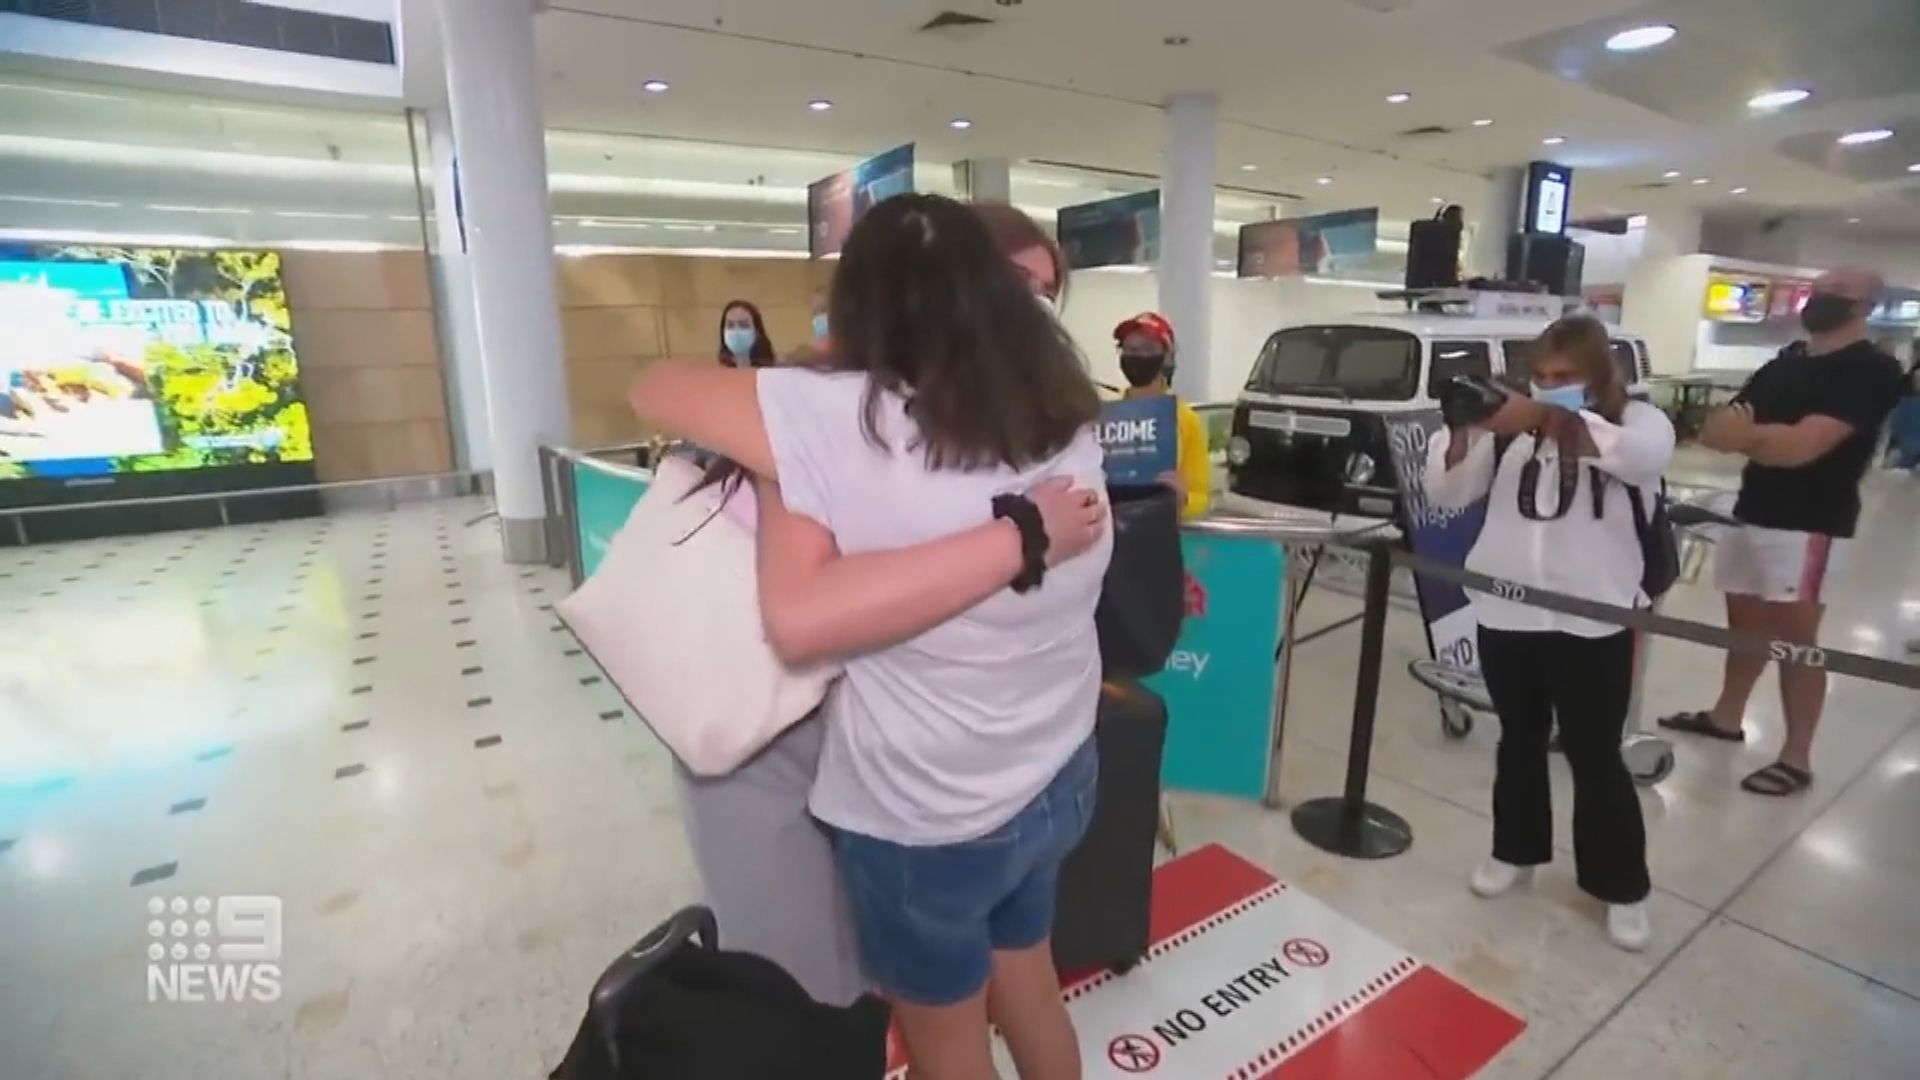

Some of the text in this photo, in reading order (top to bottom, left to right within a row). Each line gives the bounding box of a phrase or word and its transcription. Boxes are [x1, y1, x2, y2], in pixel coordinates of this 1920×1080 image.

[1094, 418, 1157, 444] LCOME
[1391, 422, 1426, 454] SYD
[1491, 579, 1525, 601] SYD
[1769, 640, 1825, 668] SYD
[1153, 957, 1290, 1047] NO ENTRY
